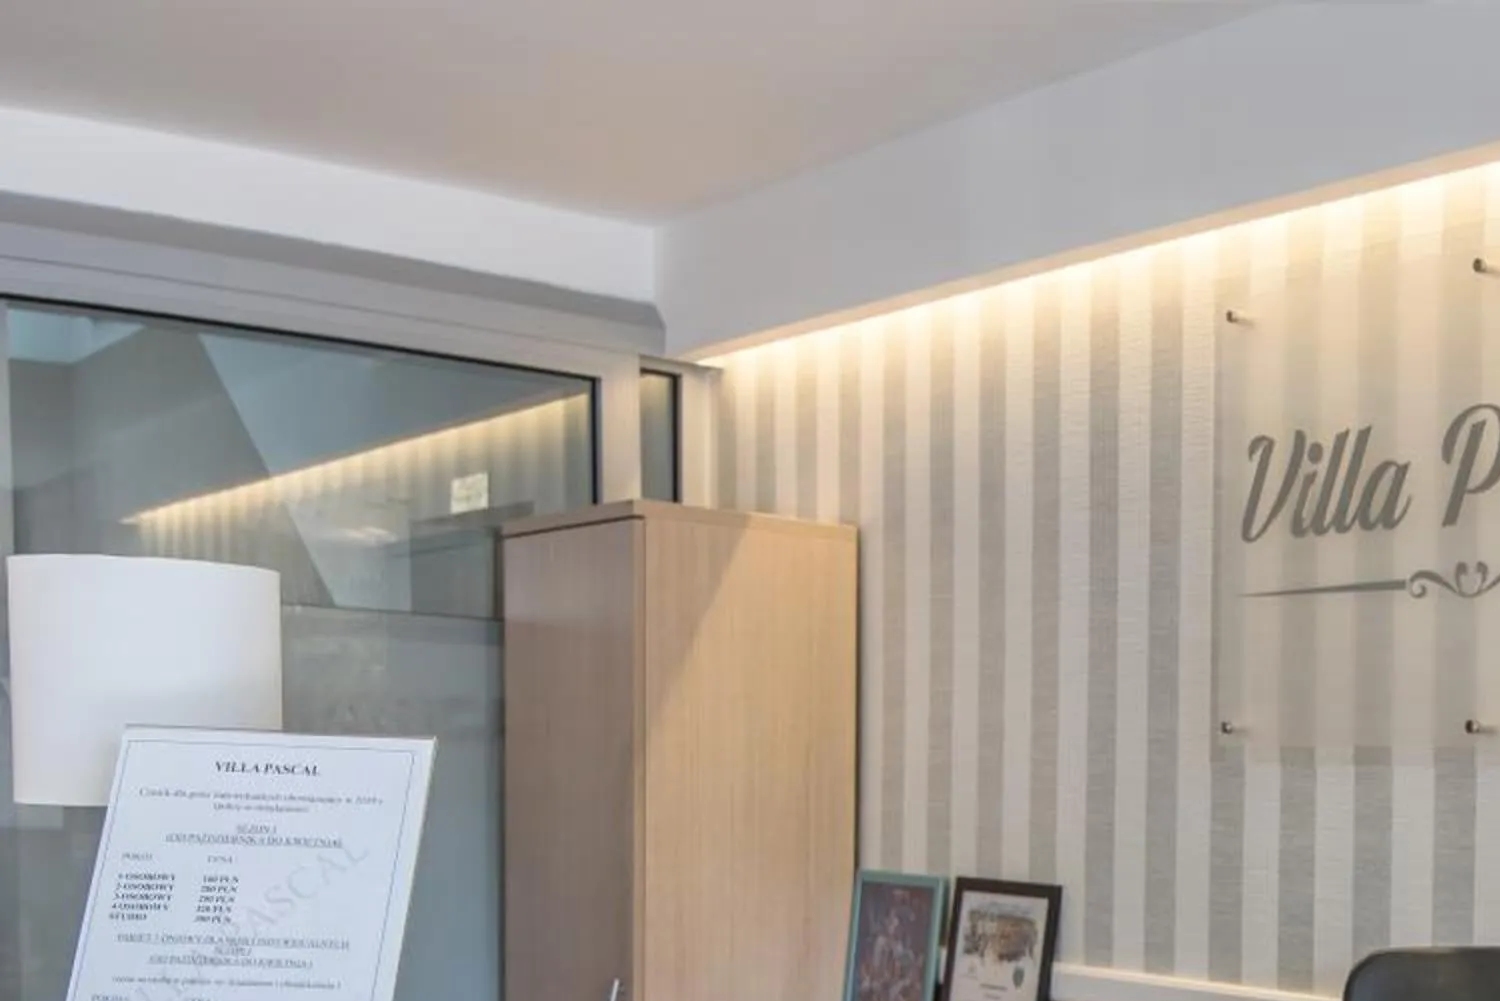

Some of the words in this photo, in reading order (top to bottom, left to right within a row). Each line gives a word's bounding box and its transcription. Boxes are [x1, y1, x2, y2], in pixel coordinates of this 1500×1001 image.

[1241, 424, 1412, 543] Villa
[215, 761, 260, 774] VILLA
[263, 763, 321, 777] PASCAL
